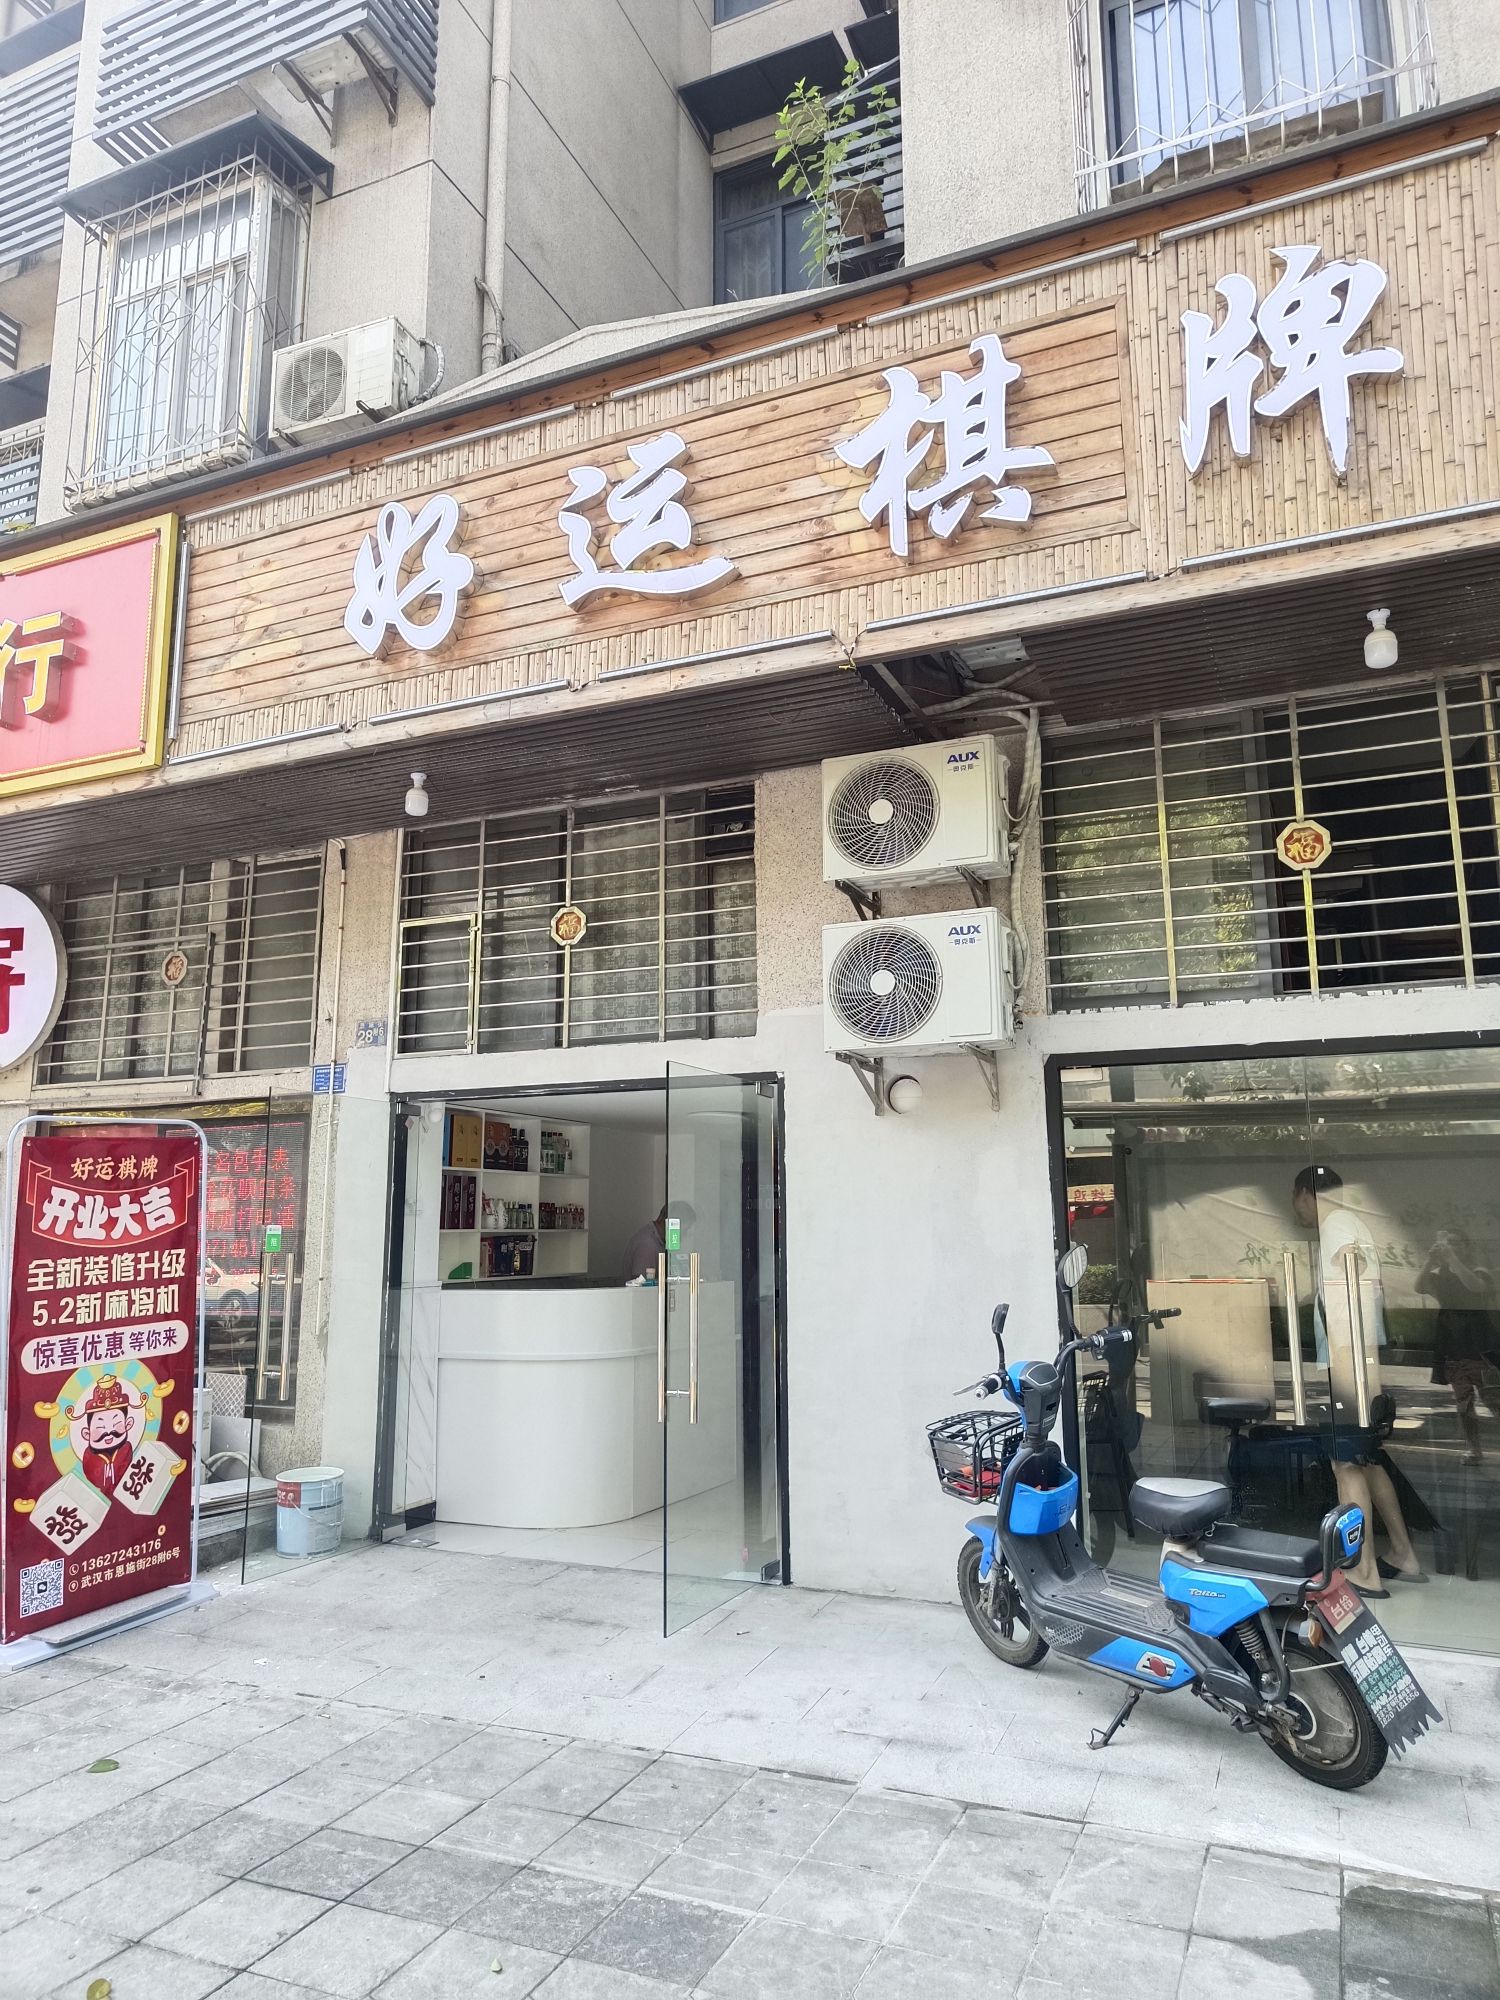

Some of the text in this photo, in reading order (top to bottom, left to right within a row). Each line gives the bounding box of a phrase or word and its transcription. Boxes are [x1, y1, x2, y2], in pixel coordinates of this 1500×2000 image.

[343, 244, 1405, 657] 好运棋牌
[947, 750, 980, 764] AUX
[947, 924, 981, 937] AUX
[69, 1154, 158, 1181] 好运棋牌
[38, 1186, 176, 1241] 开业大吉
[27, 1248, 187, 1292] 全新装修升级
[32, 1284, 180, 1327] 5.2新麻将机
[33, 1326, 178, 1371] 惊喜优惠 等你来
[80, 1538, 162, 1574] 13627243176
[80, 1546, 181, 1590] 武汉市恩施街28附6号
